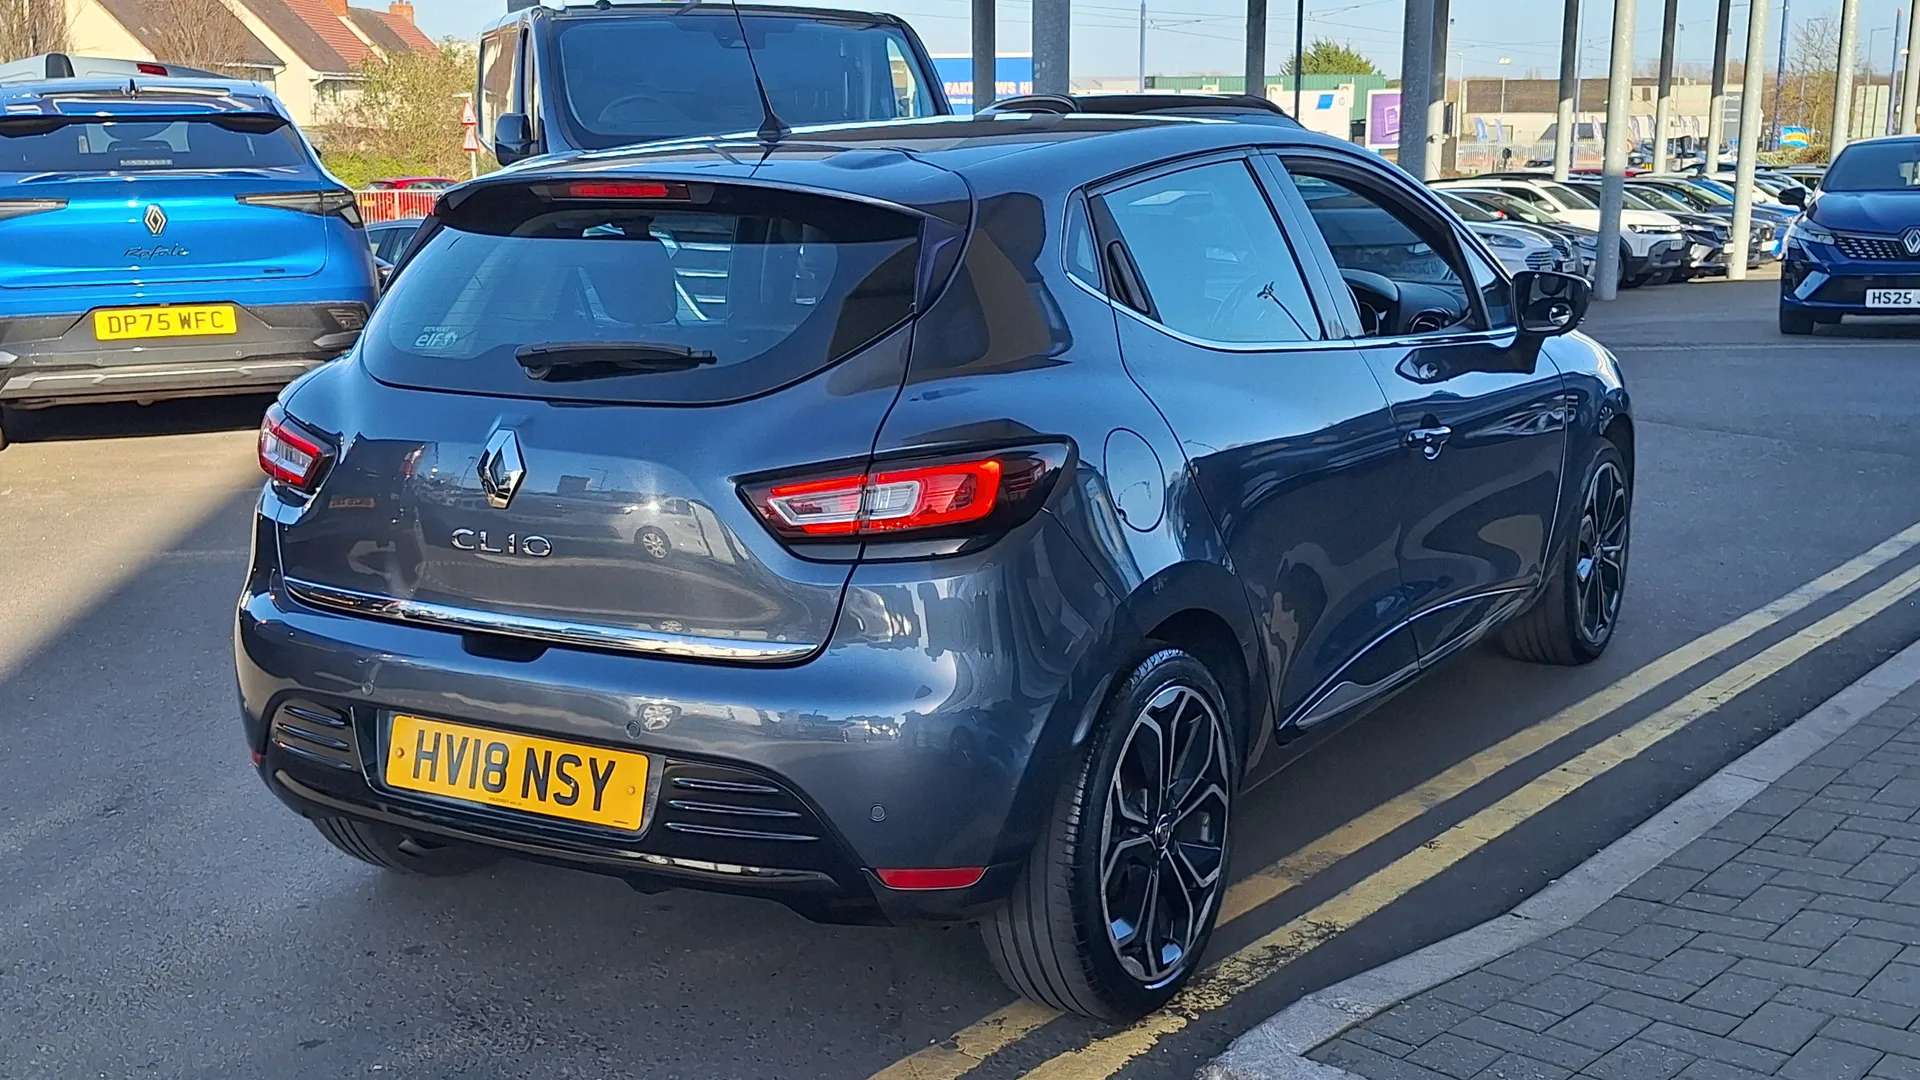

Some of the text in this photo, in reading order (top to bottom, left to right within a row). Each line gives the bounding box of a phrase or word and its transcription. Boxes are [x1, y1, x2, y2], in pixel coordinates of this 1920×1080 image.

[1872, 291, 1912, 305] HS25
[107, 310, 225, 334] DP75 WFC
[451, 528, 552, 557] CLIO
[412, 729, 617, 812] HV18 NSY
